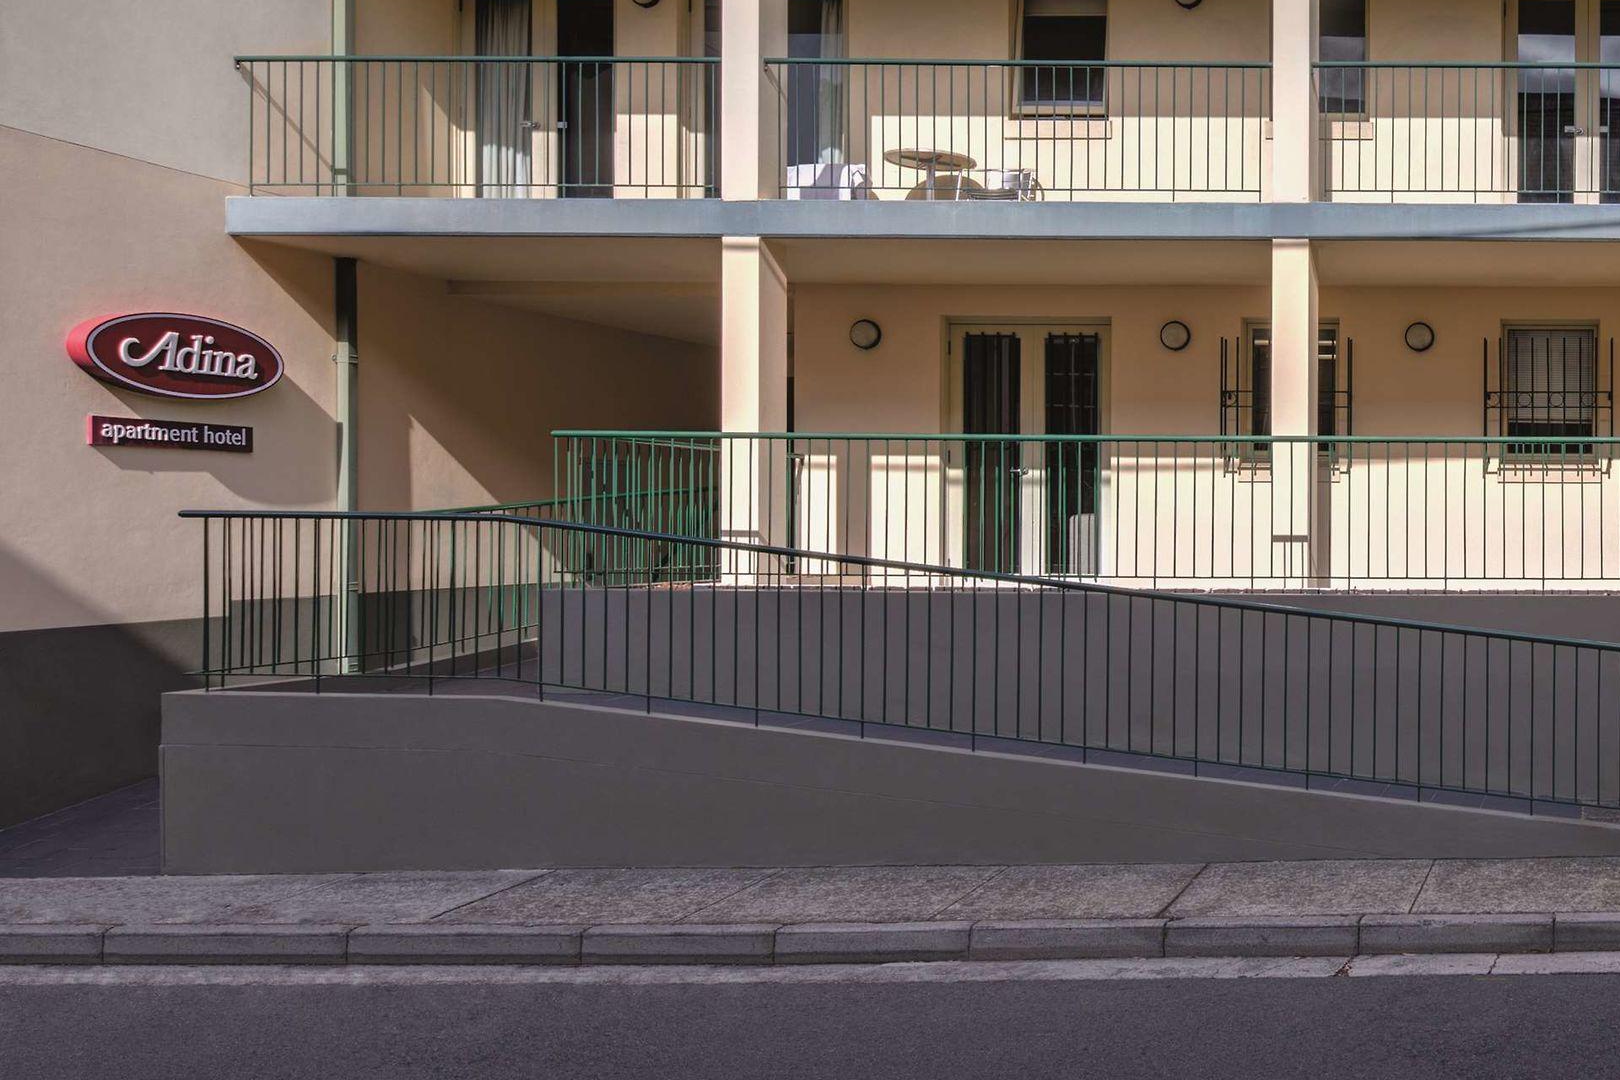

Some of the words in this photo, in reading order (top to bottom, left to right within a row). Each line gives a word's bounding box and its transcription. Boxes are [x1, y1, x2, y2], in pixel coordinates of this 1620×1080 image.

[118, 331, 258, 380] Adina
[101, 422, 199, 444] apartment
[203, 426, 247, 446] hotel
